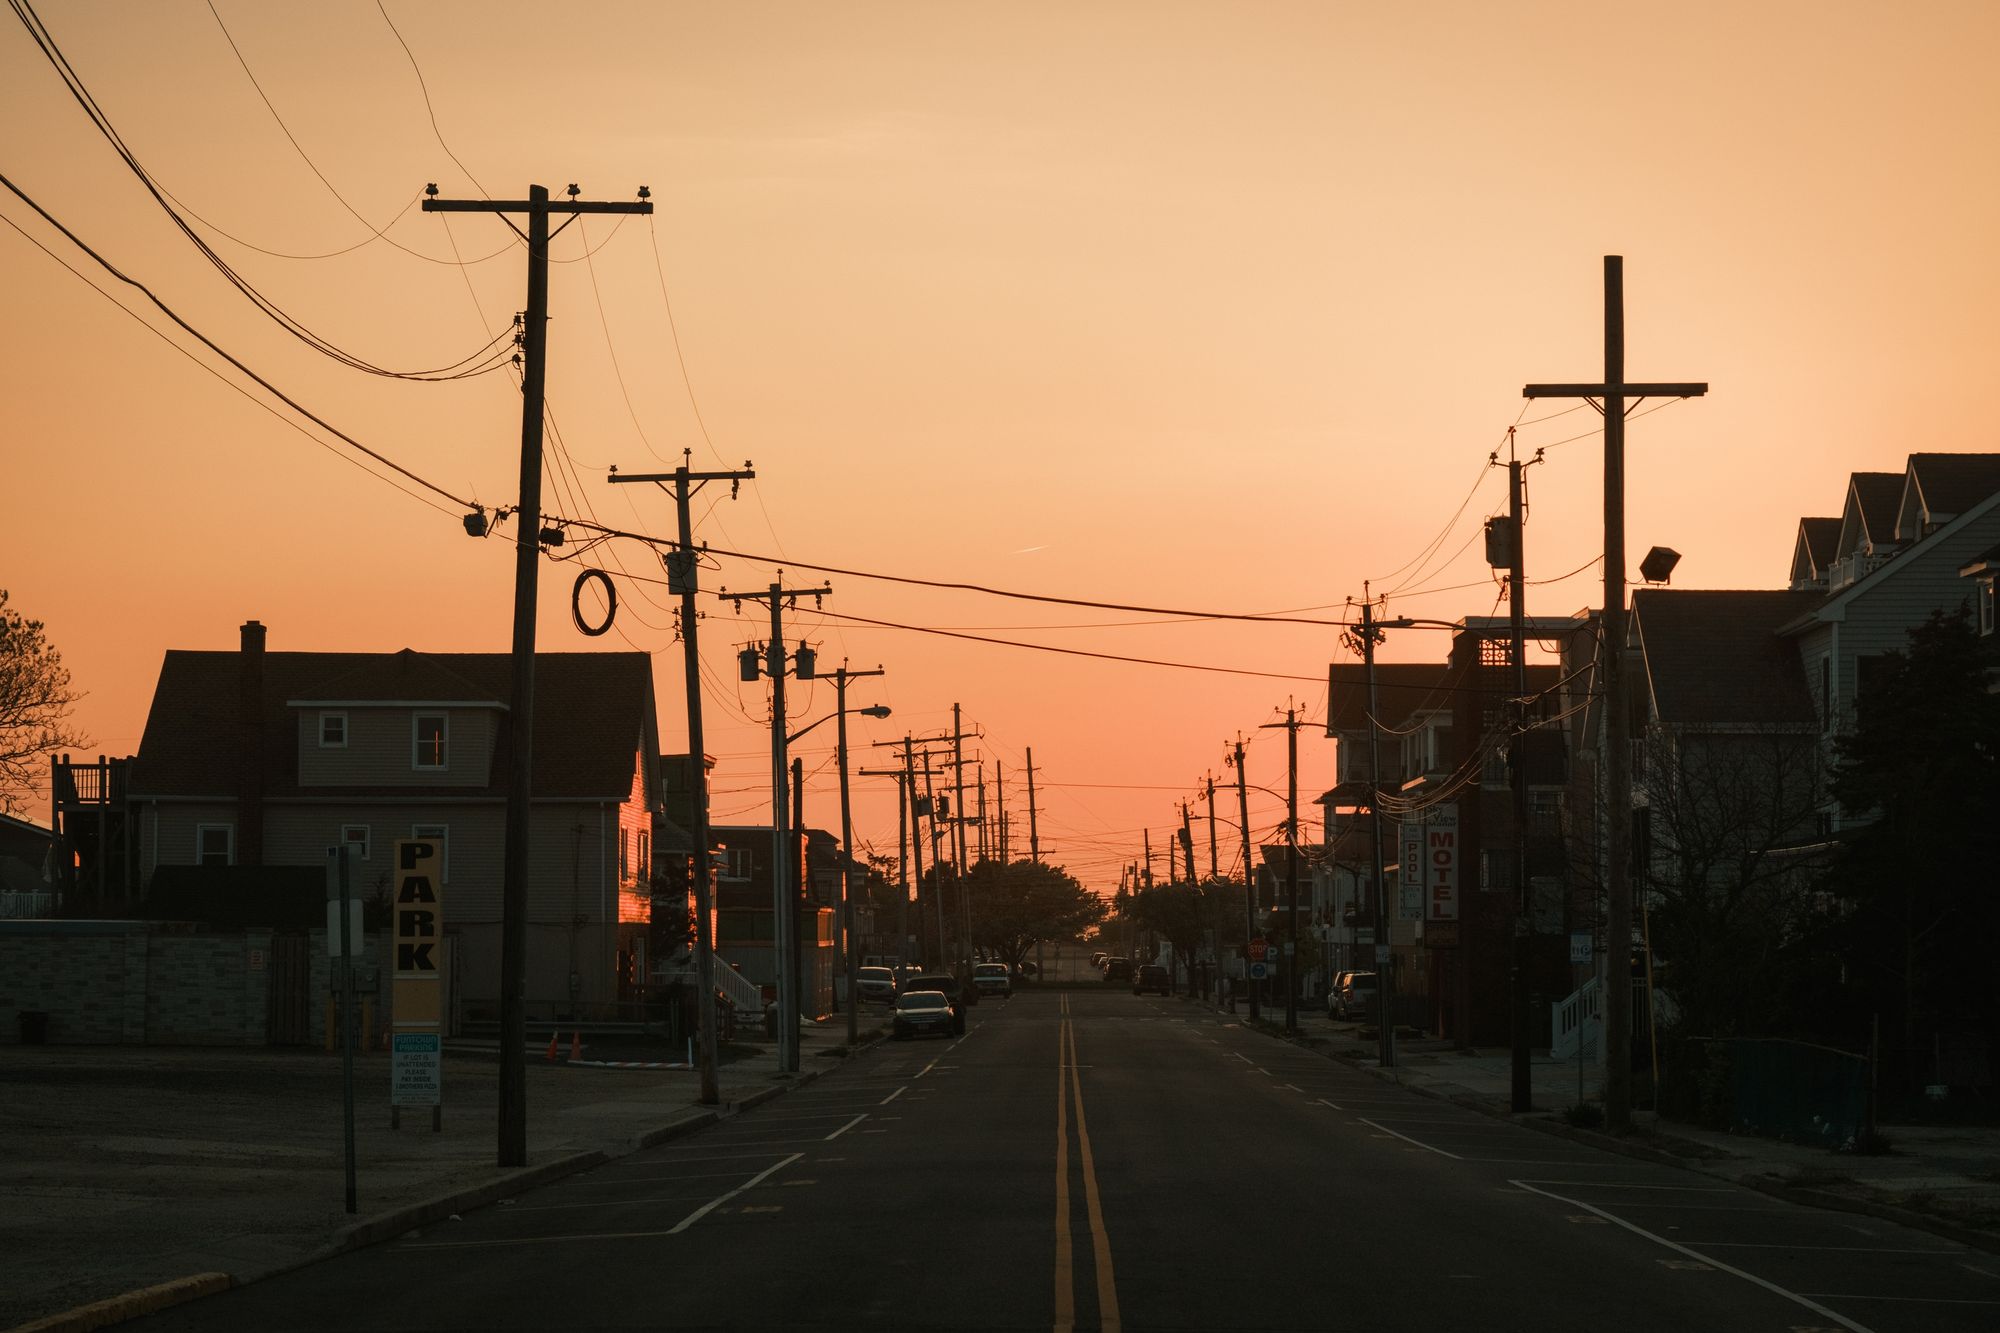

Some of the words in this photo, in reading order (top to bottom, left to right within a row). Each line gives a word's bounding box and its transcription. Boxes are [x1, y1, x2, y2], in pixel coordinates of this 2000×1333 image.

[1408, 843, 1418, 883] POOL
[1430, 832, 1454, 918] MOTEL
[398, 843, 436, 970] PARK
[1249, 944, 1267, 953] STOP
